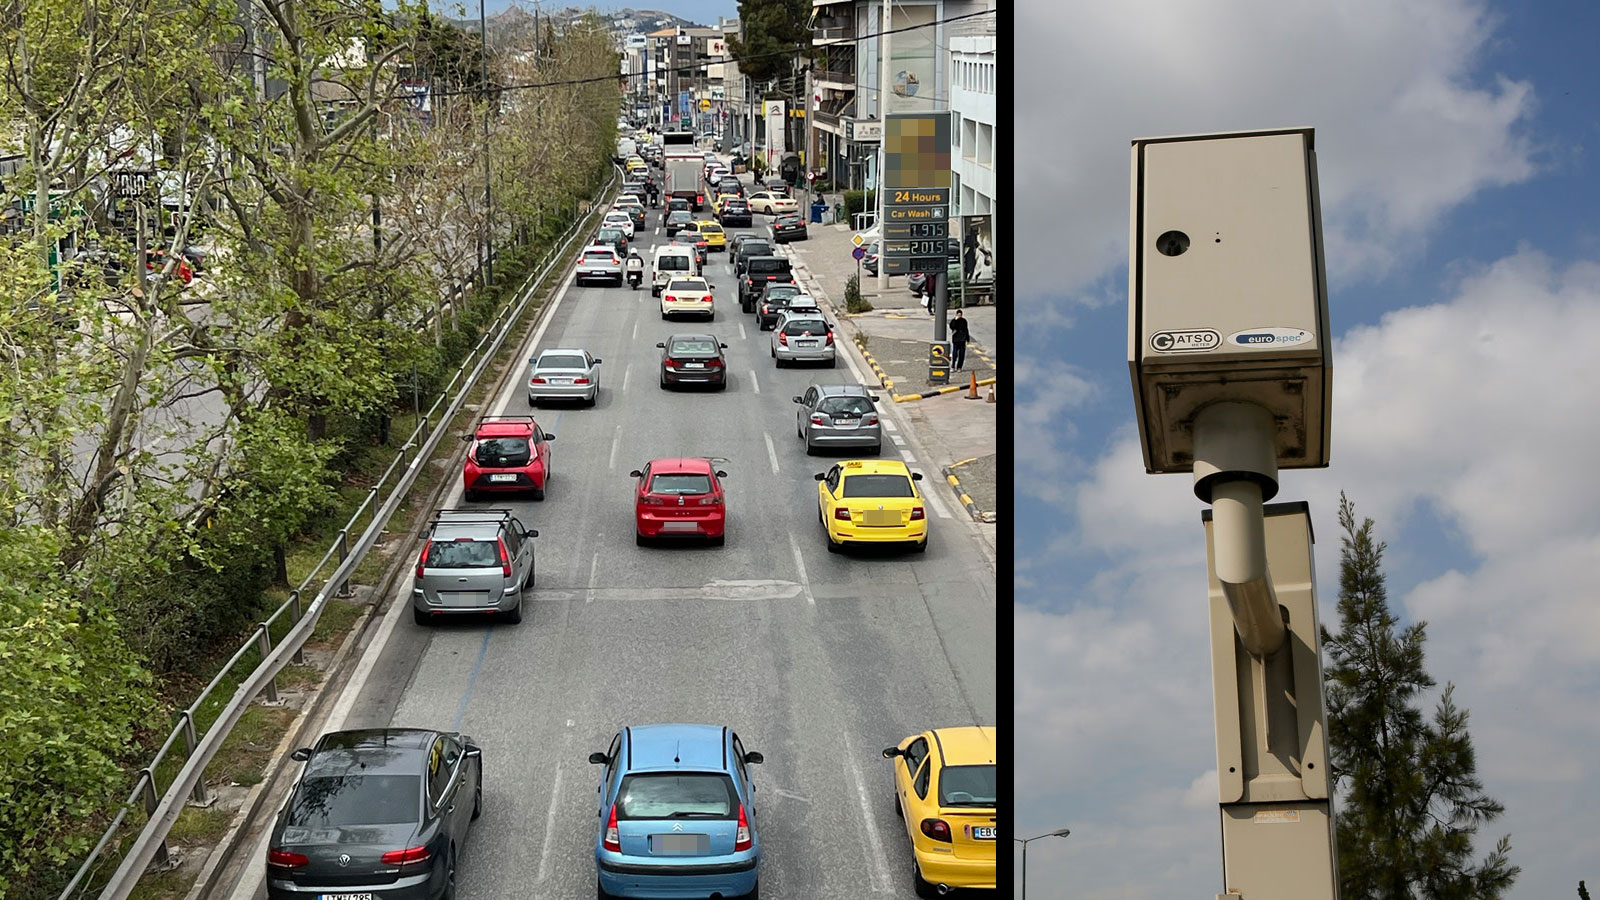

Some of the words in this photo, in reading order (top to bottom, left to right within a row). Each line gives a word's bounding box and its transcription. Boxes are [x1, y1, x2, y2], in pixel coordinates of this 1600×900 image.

[895, 191, 910, 203] 24
[912, 193, 941, 202] Hours
[891, 210, 906, 218] Car
[908, 210, 931, 218] Wash
[1151, 333, 1213, 350] GATSO
[1275, 335, 1301, 343] spec
